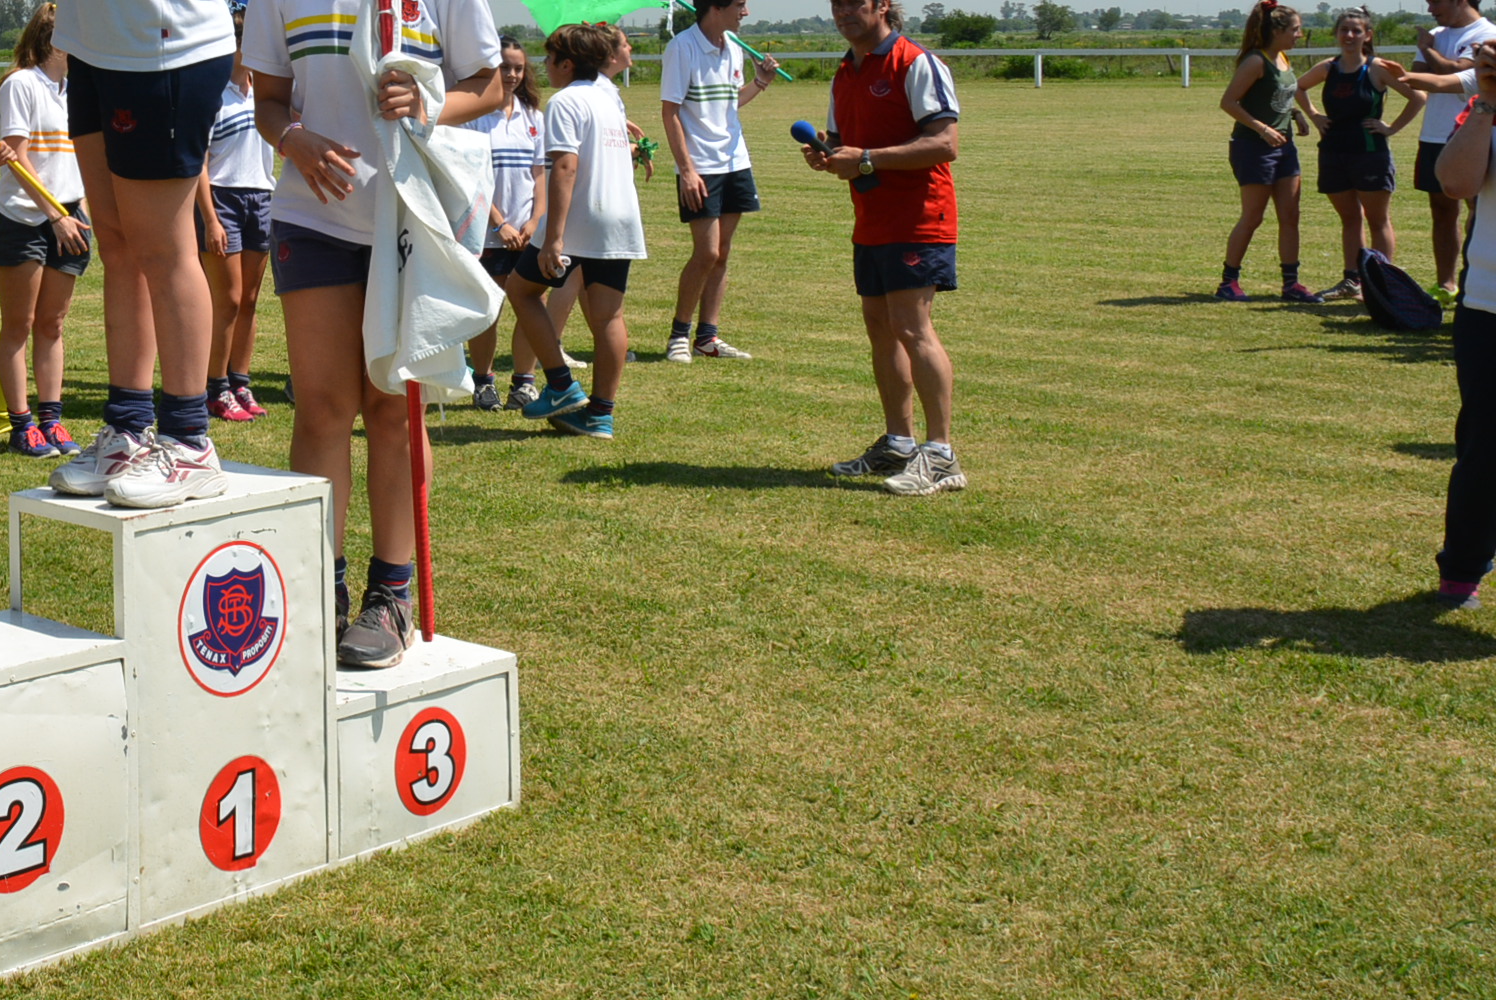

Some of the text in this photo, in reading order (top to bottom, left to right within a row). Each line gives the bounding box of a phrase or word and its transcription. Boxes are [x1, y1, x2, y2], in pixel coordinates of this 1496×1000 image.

[196, 624, 273, 664] TENAX PROPOSITI
[409, 718, 456, 806] 3
[216, 768, 256, 861] 1
